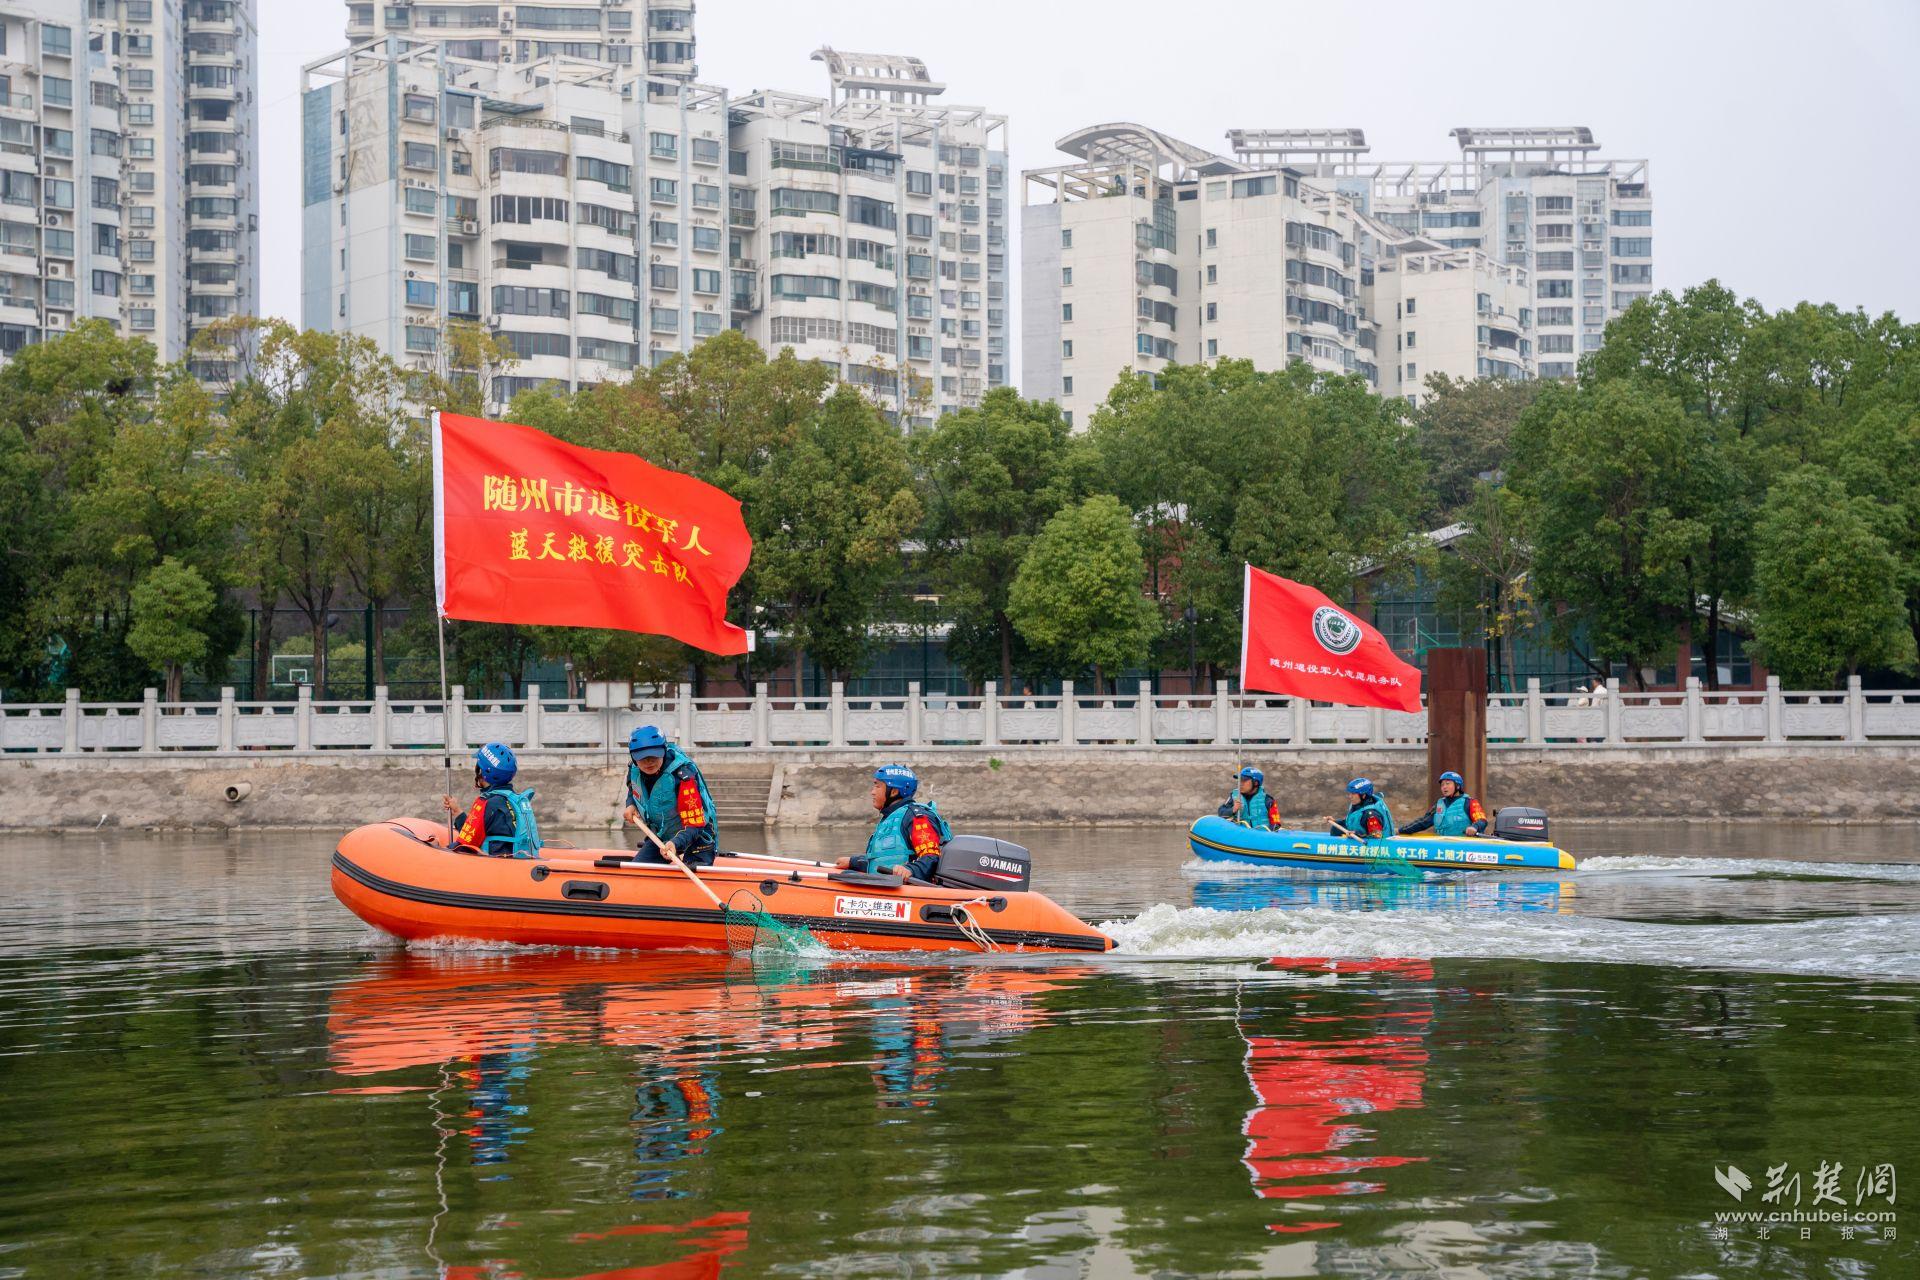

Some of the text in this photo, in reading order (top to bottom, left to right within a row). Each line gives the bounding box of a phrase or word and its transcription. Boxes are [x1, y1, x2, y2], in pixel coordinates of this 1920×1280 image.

[483, 475, 712, 556] 随州市退役军人
[509, 528, 694, 588] 蓝天救援突击队
[1269, 658, 1402, 687] 随州退役军人志愿服务队
[990, 858, 1023, 873] YAMAHA
